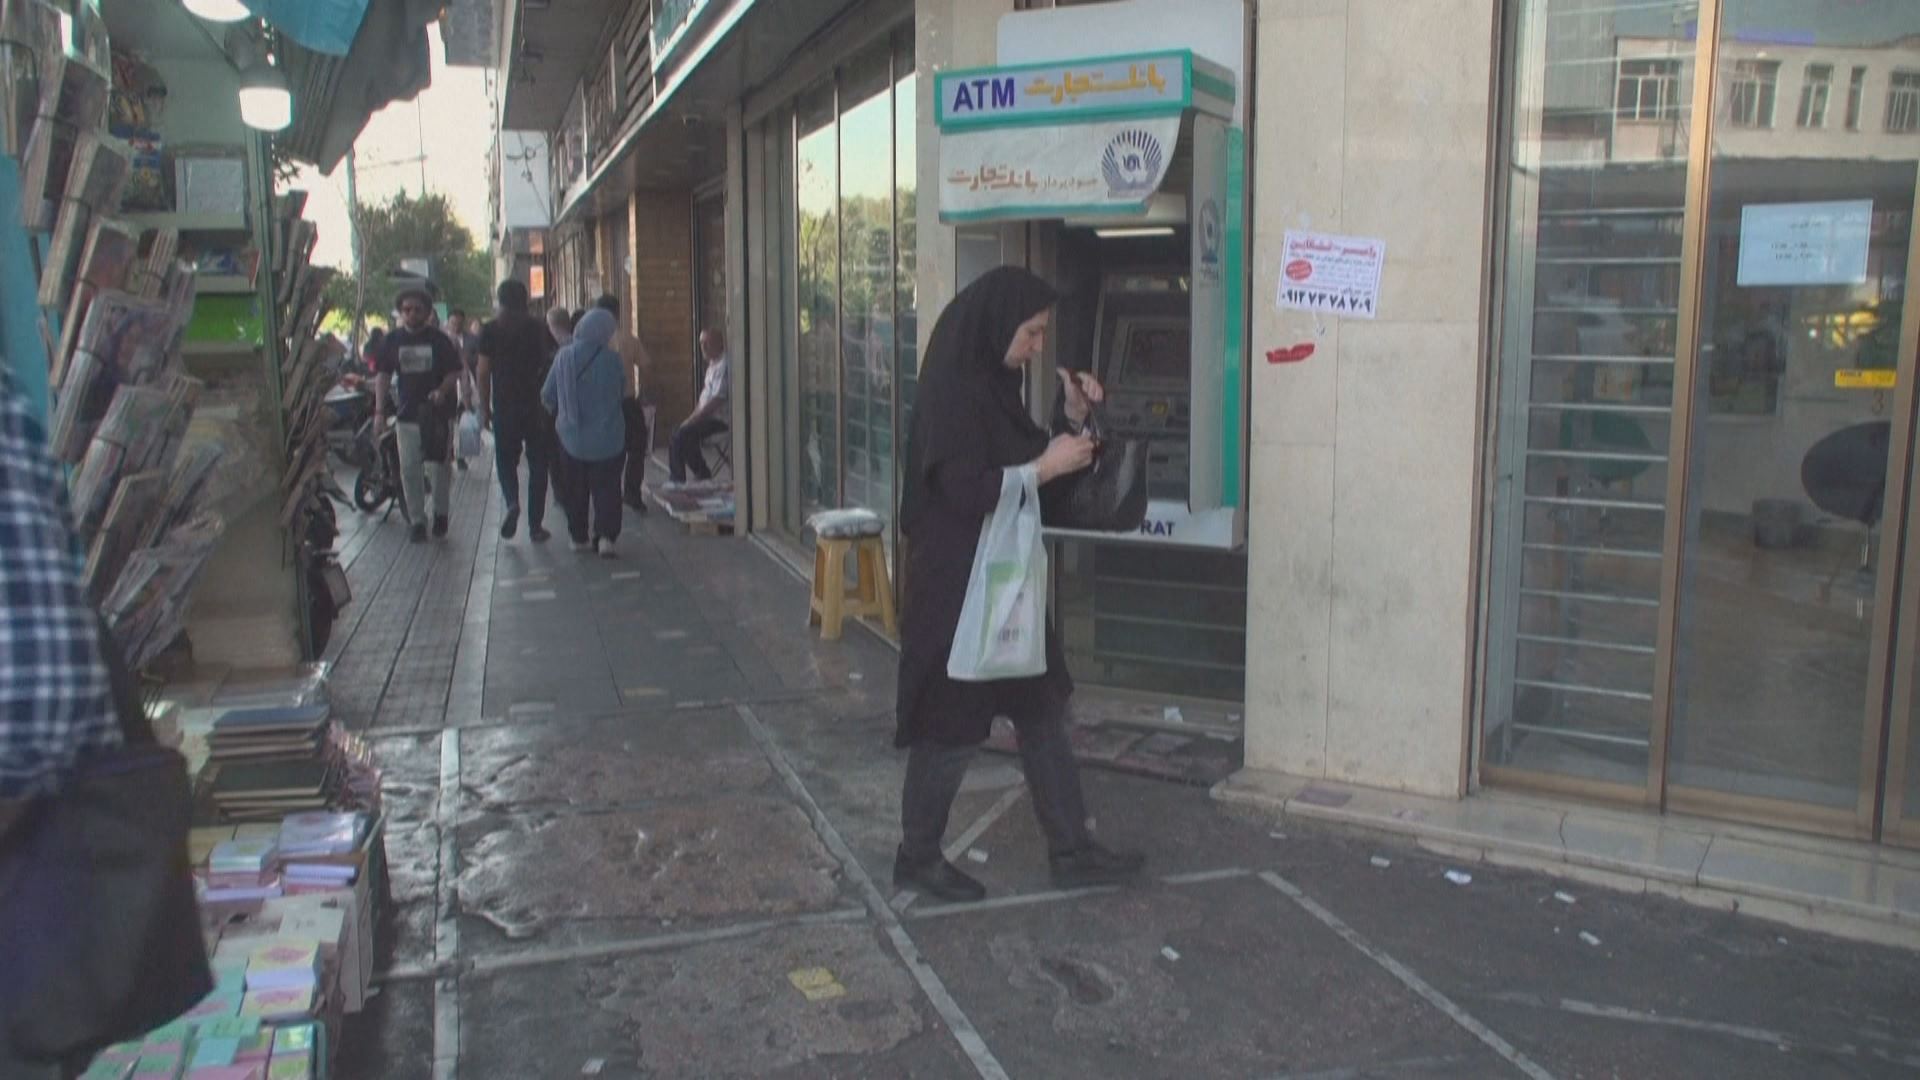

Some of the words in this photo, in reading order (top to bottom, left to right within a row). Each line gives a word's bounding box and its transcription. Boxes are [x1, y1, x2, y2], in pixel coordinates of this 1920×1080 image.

[953, 77, 1016, 112] ATM
[1023, 70, 1104, 105] تجارت
[946, 163, 1007, 191] تجارت
